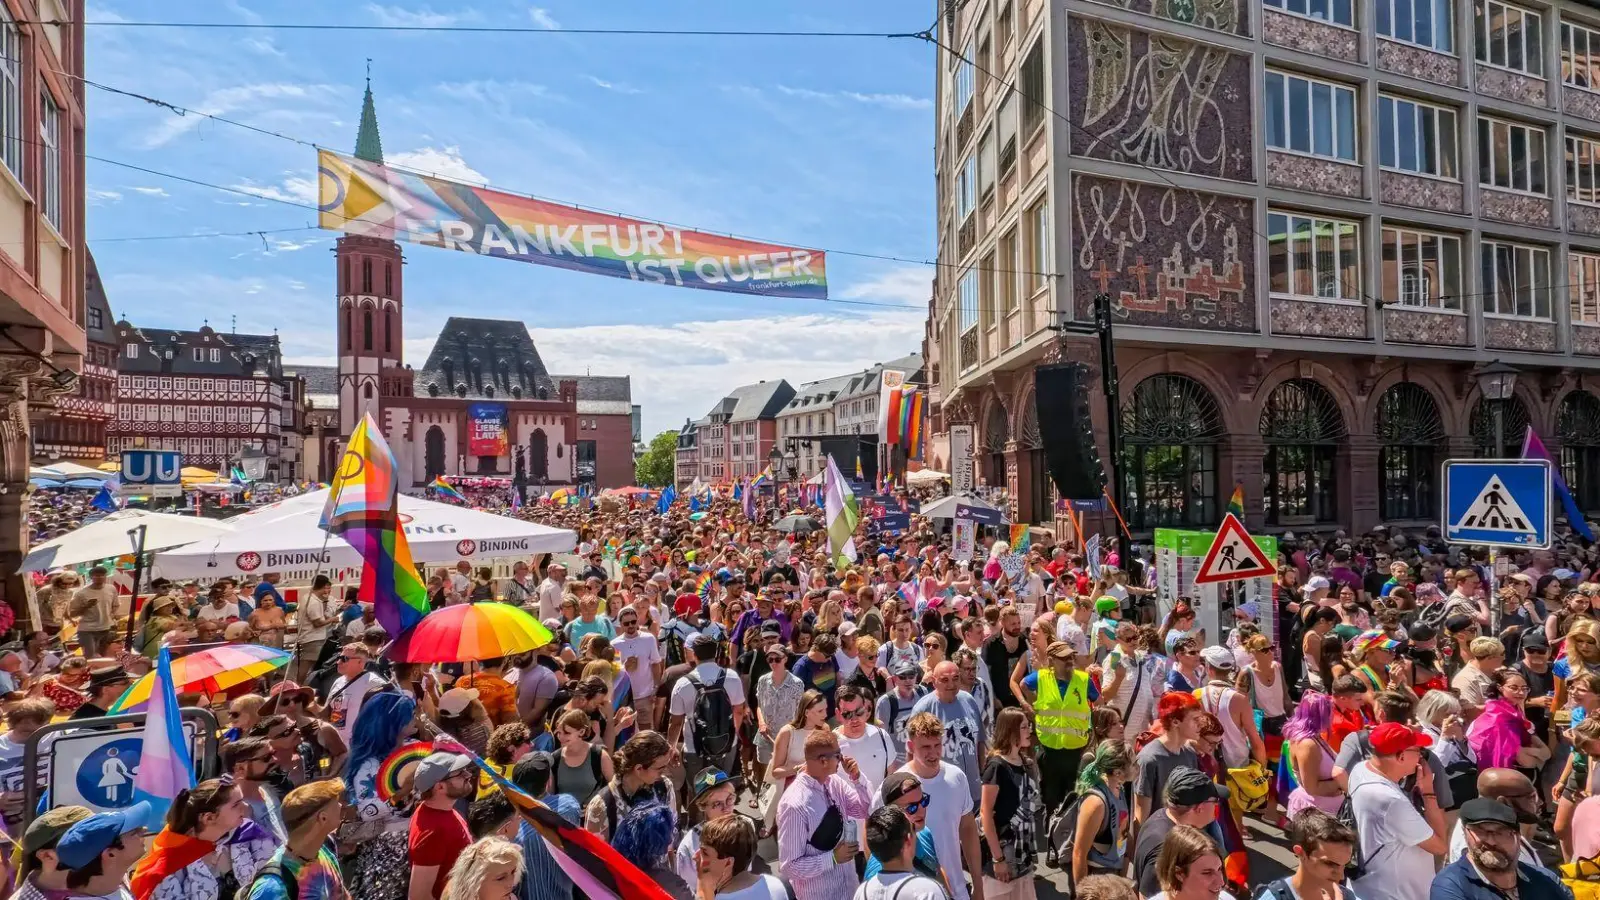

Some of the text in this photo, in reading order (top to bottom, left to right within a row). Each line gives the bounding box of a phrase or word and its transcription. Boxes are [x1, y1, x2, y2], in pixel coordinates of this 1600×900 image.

[406, 219, 685, 257] FRANKFURT
[626, 250, 814, 286] IST QUEER
[748, 278, 818, 290] frankfurt-queer.de
[124, 454, 151, 481] U
[156, 454, 179, 481] U
[960, 443, 973, 491] Tourist Info
[267, 550, 331, 567] BINDING
[479, 538, 528, 553] BINDING
